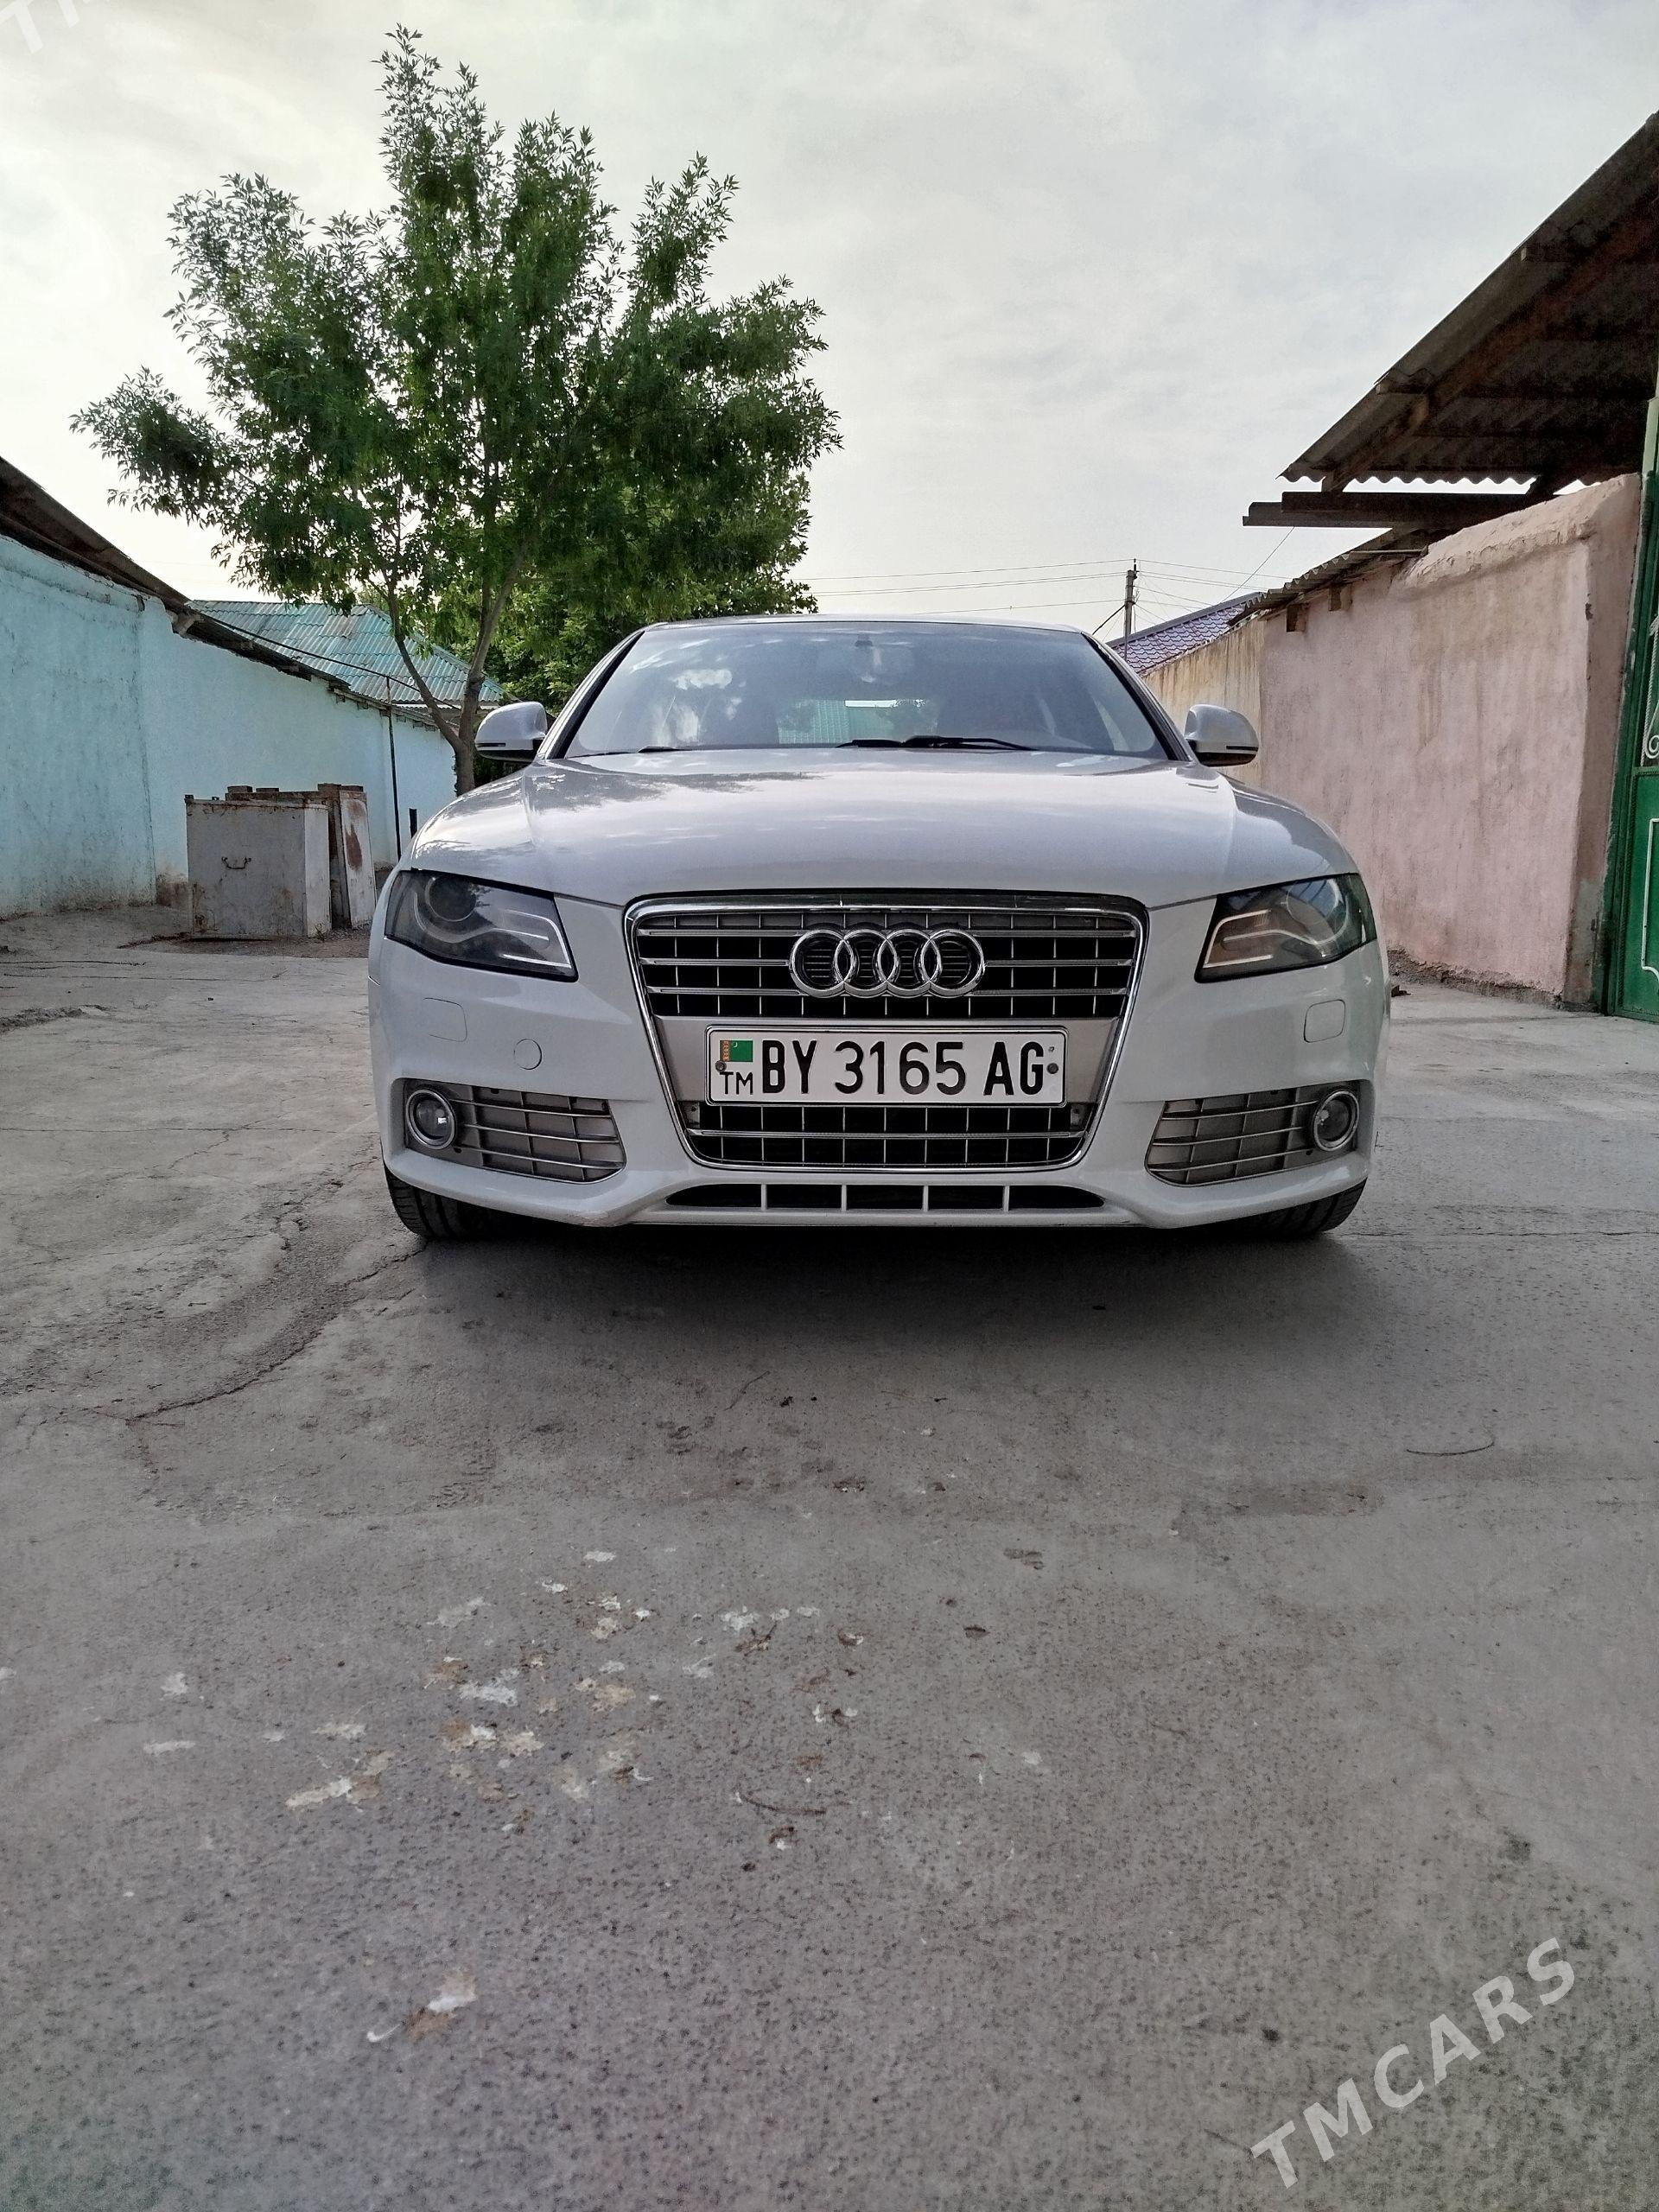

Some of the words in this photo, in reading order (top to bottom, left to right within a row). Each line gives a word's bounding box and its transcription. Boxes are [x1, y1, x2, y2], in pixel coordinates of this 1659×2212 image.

[720, 1071, 753, 1095] TM
[762, 1039, 817, 1094] BY
[835, 1040, 966, 1096] 3165
[983, 1041, 1044, 1096] AG
